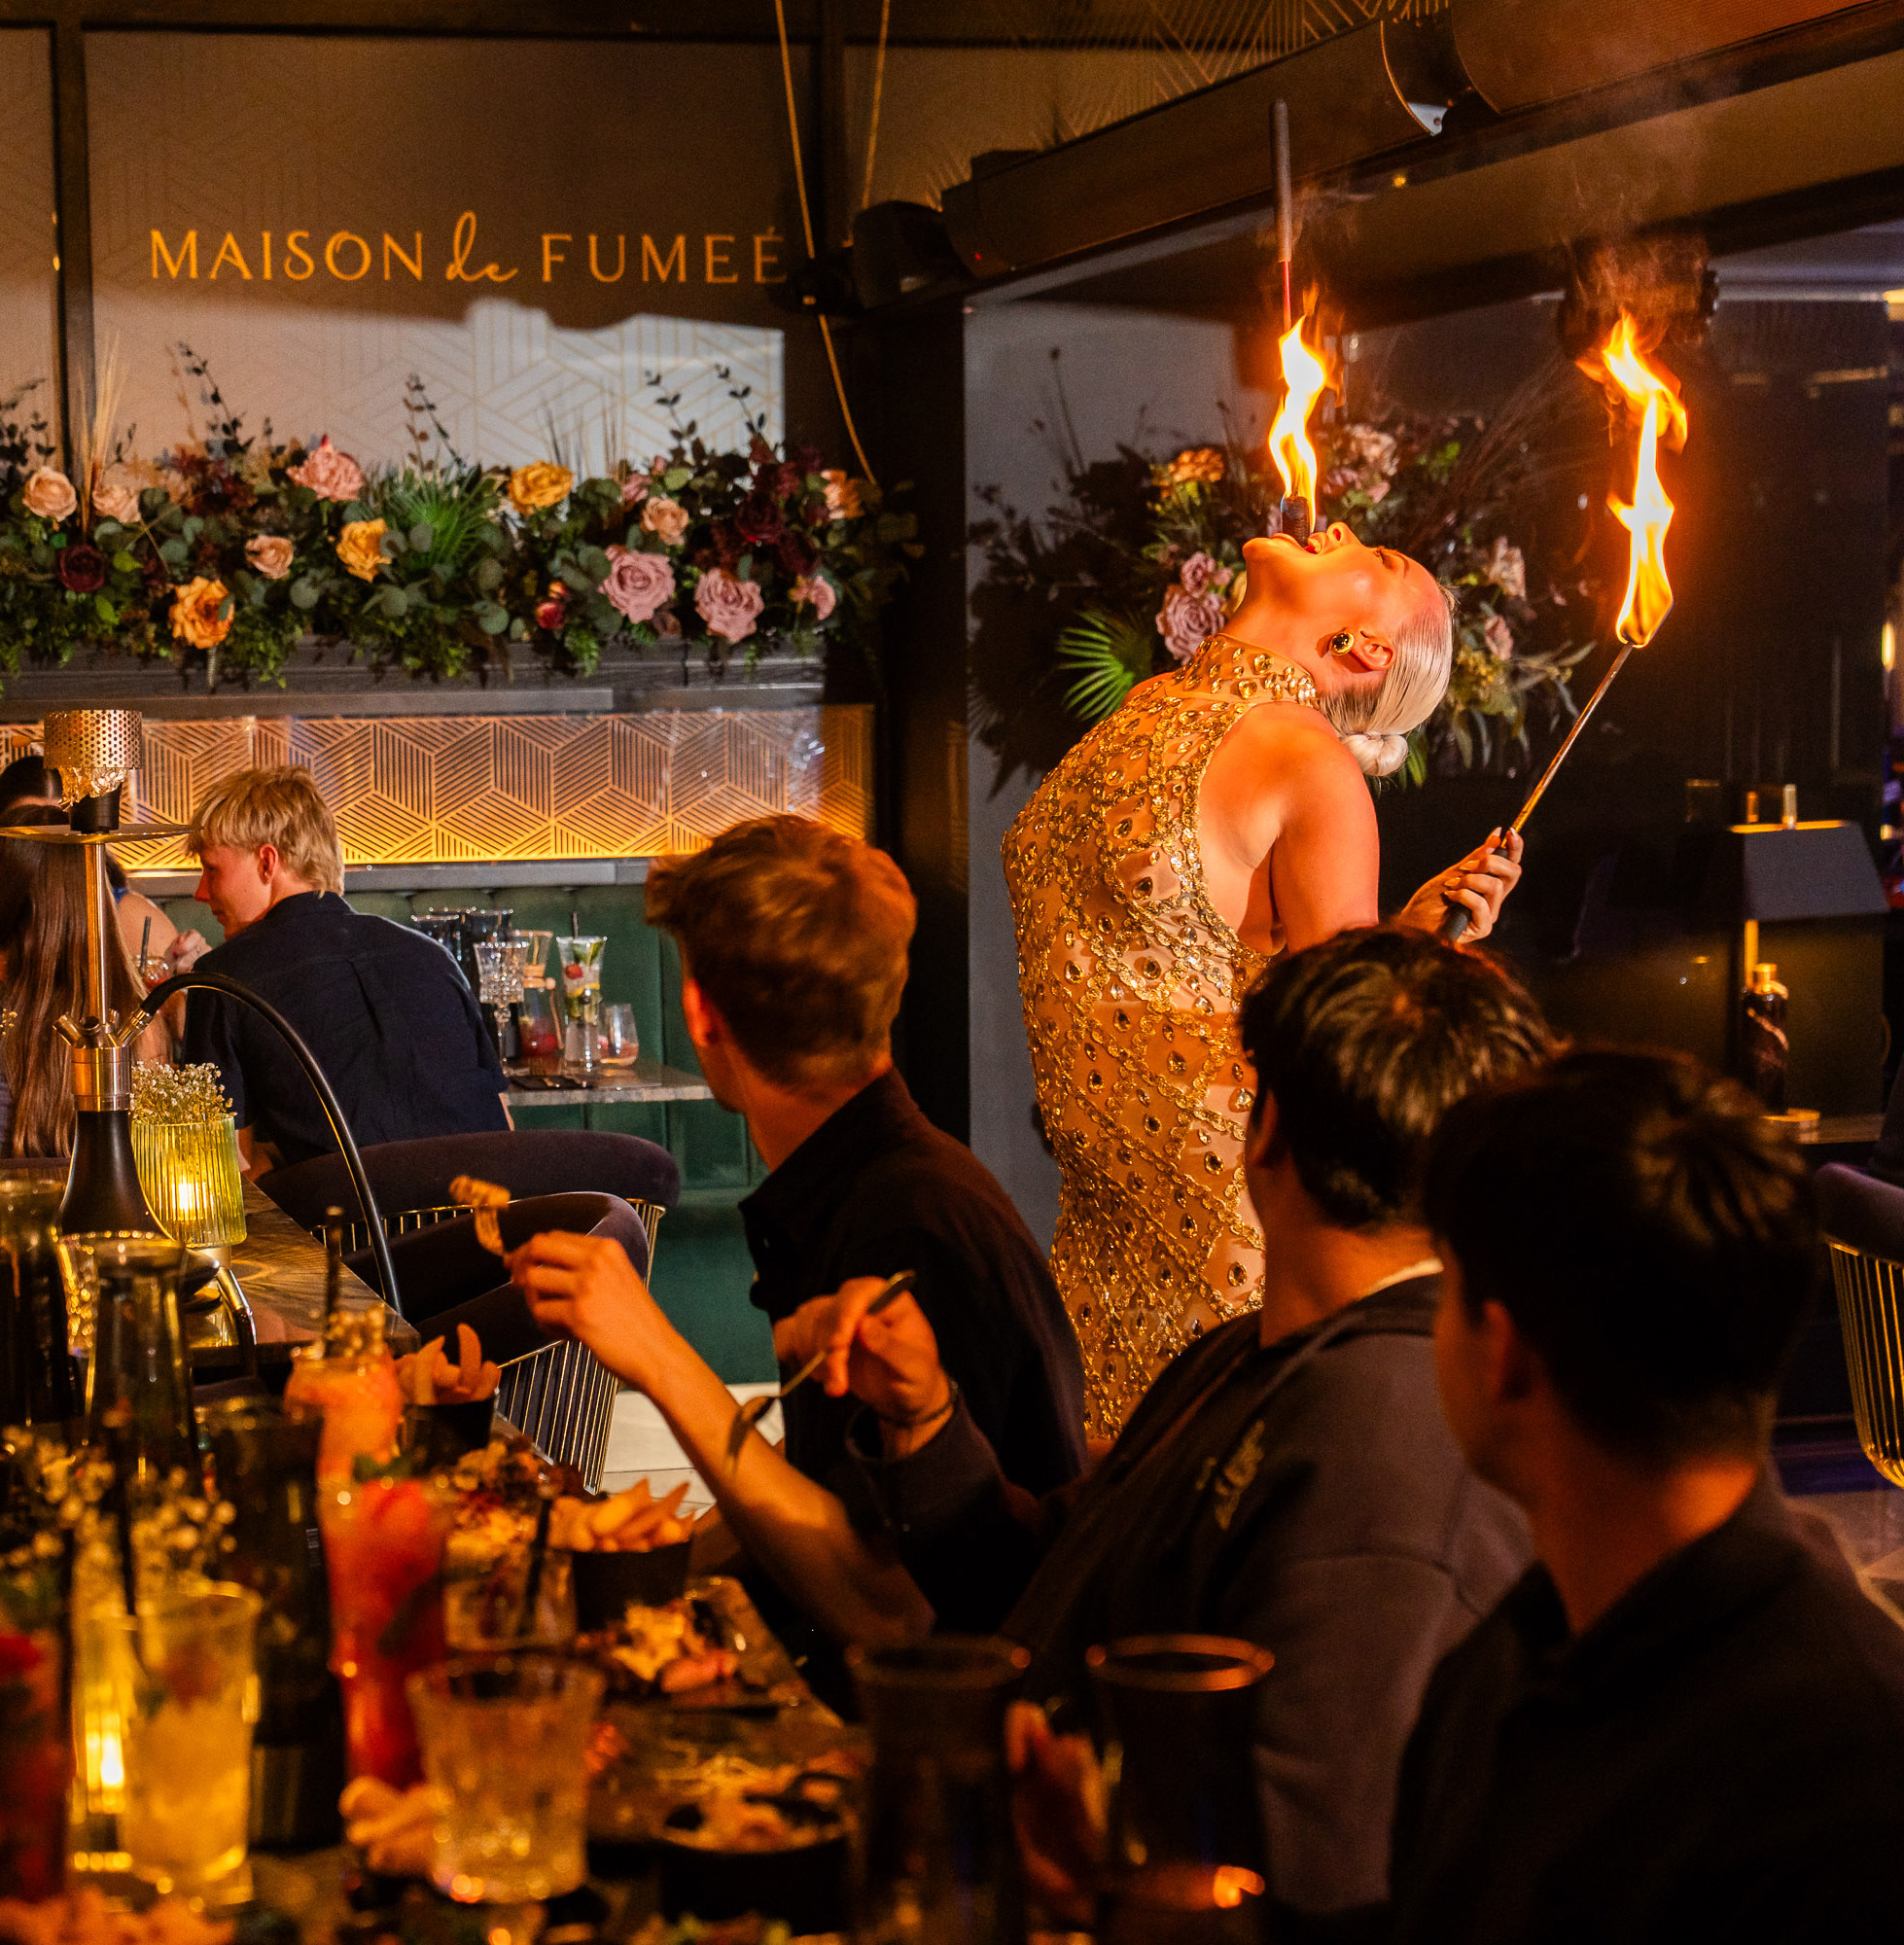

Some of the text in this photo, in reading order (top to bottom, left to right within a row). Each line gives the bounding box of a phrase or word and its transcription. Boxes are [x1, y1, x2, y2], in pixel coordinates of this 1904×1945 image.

[150, 210, 788, 284] MAISON de FUMEÉ
